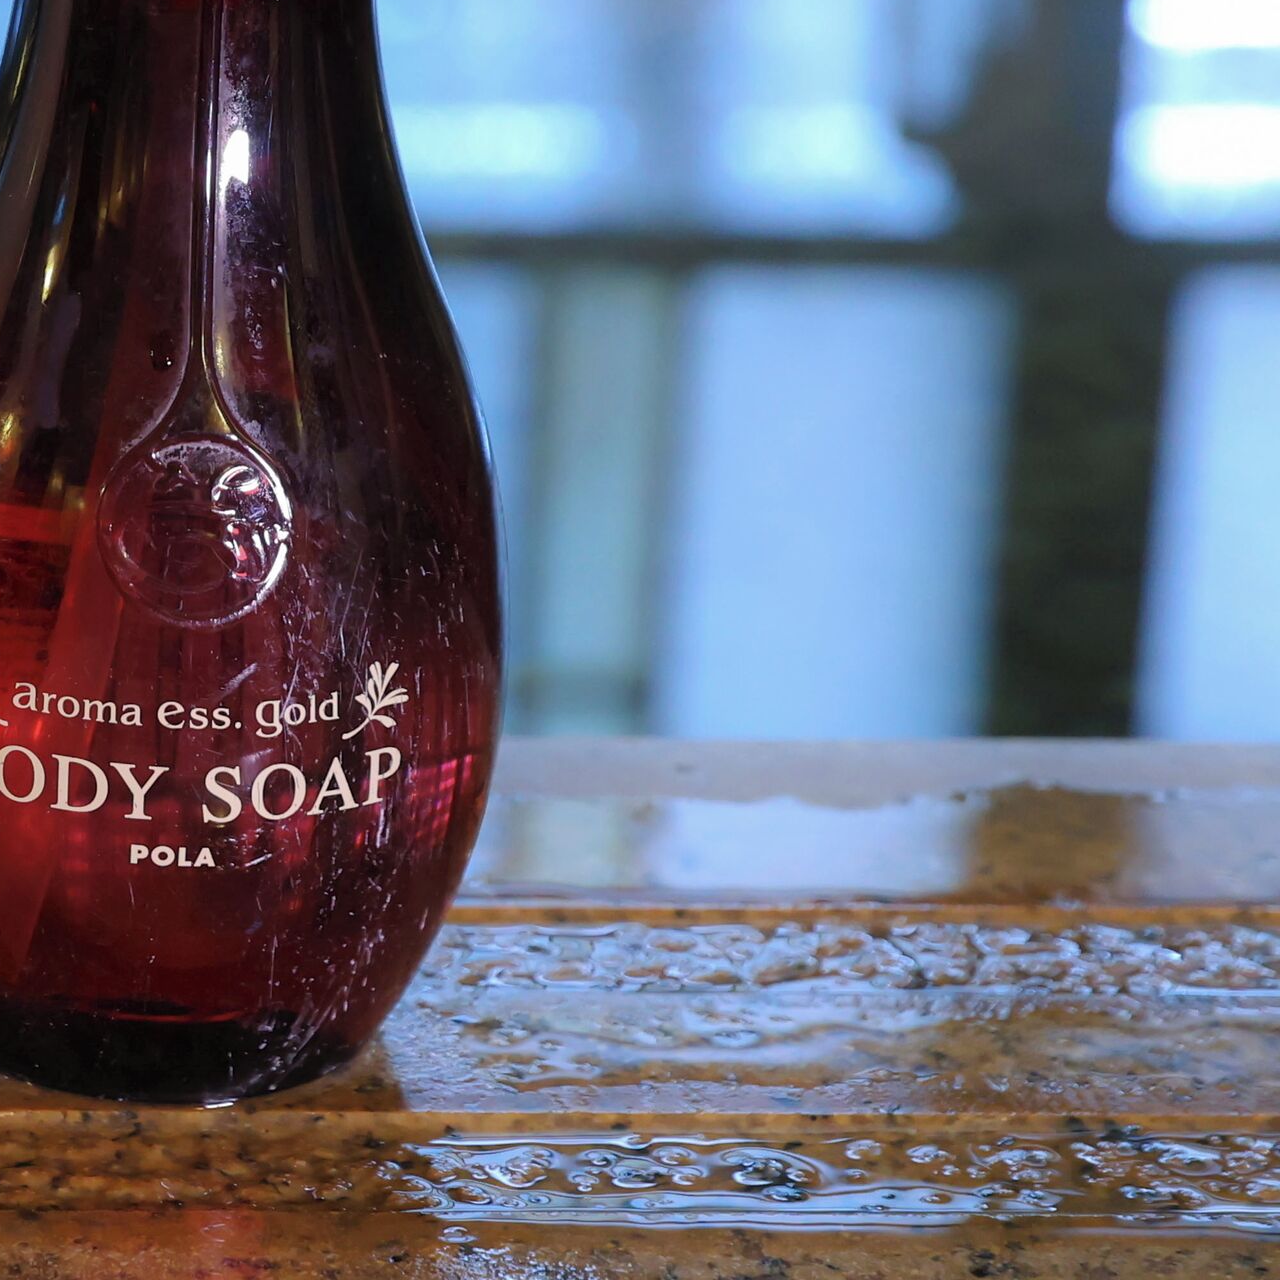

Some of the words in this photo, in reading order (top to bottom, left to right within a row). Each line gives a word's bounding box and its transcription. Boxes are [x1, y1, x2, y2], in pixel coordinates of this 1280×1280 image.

[12, 681, 143, 727] aroma
[157, 700, 243, 730] ess.
[255, 691, 340, 738] gold
[202, 746, 402, 824] SOAP
[129, 844, 216, 867] POLA
